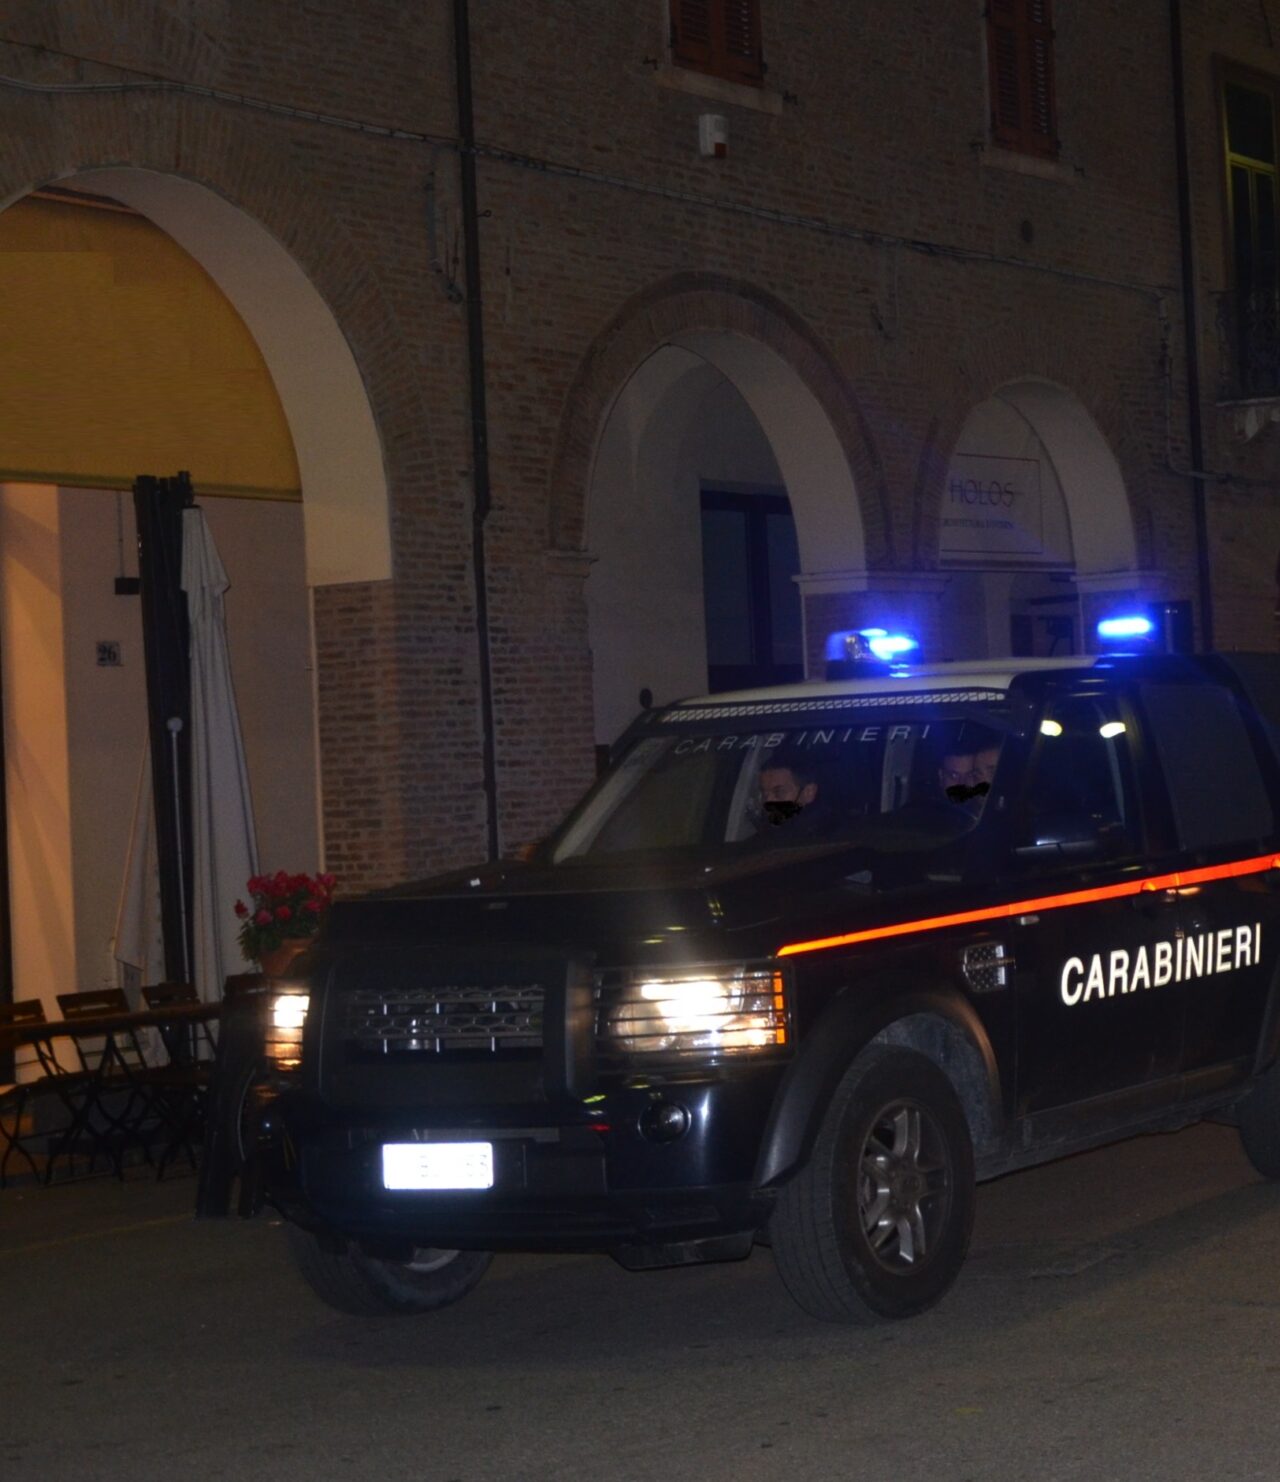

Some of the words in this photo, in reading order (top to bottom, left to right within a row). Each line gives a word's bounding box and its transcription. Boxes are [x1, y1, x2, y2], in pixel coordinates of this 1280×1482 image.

[950, 479, 1015, 508] HOLOS
[674, 724, 930, 755] CARABINIERI
[1061, 922, 1261, 1006] CARABINIERI
